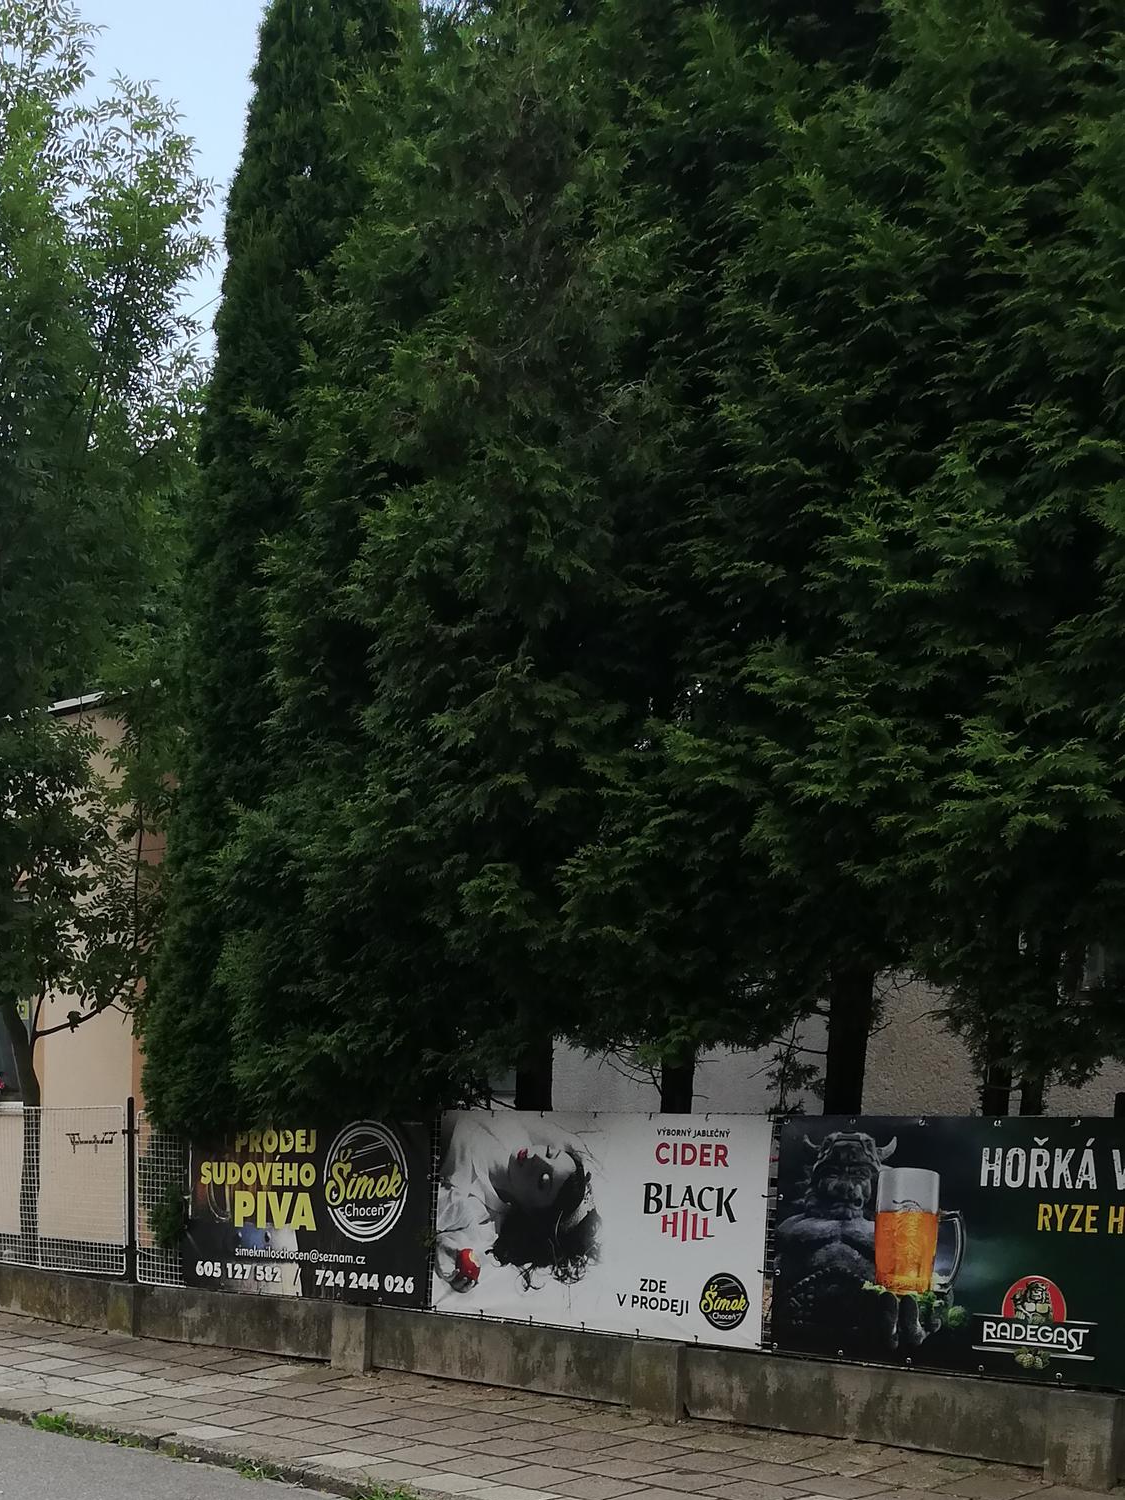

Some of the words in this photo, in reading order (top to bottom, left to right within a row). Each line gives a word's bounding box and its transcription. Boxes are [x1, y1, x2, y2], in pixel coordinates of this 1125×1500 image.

[234, 1128, 318, 1154] PRODEJ
[657, 1126, 691, 1138] VÝBORNÝ
[692, 1128, 731, 1139] JABLEČNÝ
[200, 1154, 317, 1188] SUDOVÉHO
[655, 1142, 730, 1168] CIDER
[980, 1136, 1098, 1190] HOŘKÁ
[325, 1147, 404, 1206] Šimek
[233, 1190, 318, 1232] PIVA
[344, 1202, 386, 1218] Choceň
[642, 1181, 739, 1224] BLACK
[1036, 1202, 1100, 1234] RYZE
[660, 1208, 716, 1243] HILL
[234, 1246, 366, 1265] simekmiloschocen@seznam.cz
[195, 1260, 222, 1278] 605
[226, 1263, 253, 1280] 127
[255, 1265, 282, 1283] 582
[314, 1269, 345, 1288] 724
[348, 1272, 380, 1292] 244
[384, 1275, 415, 1294] 026
[639, 1278, 668, 1294] ZDE
[616, 1293, 627, 1307] V
[631, 1294, 690, 1317] PRODEJI
[982, 1320, 1090, 1353] RADEGAST
